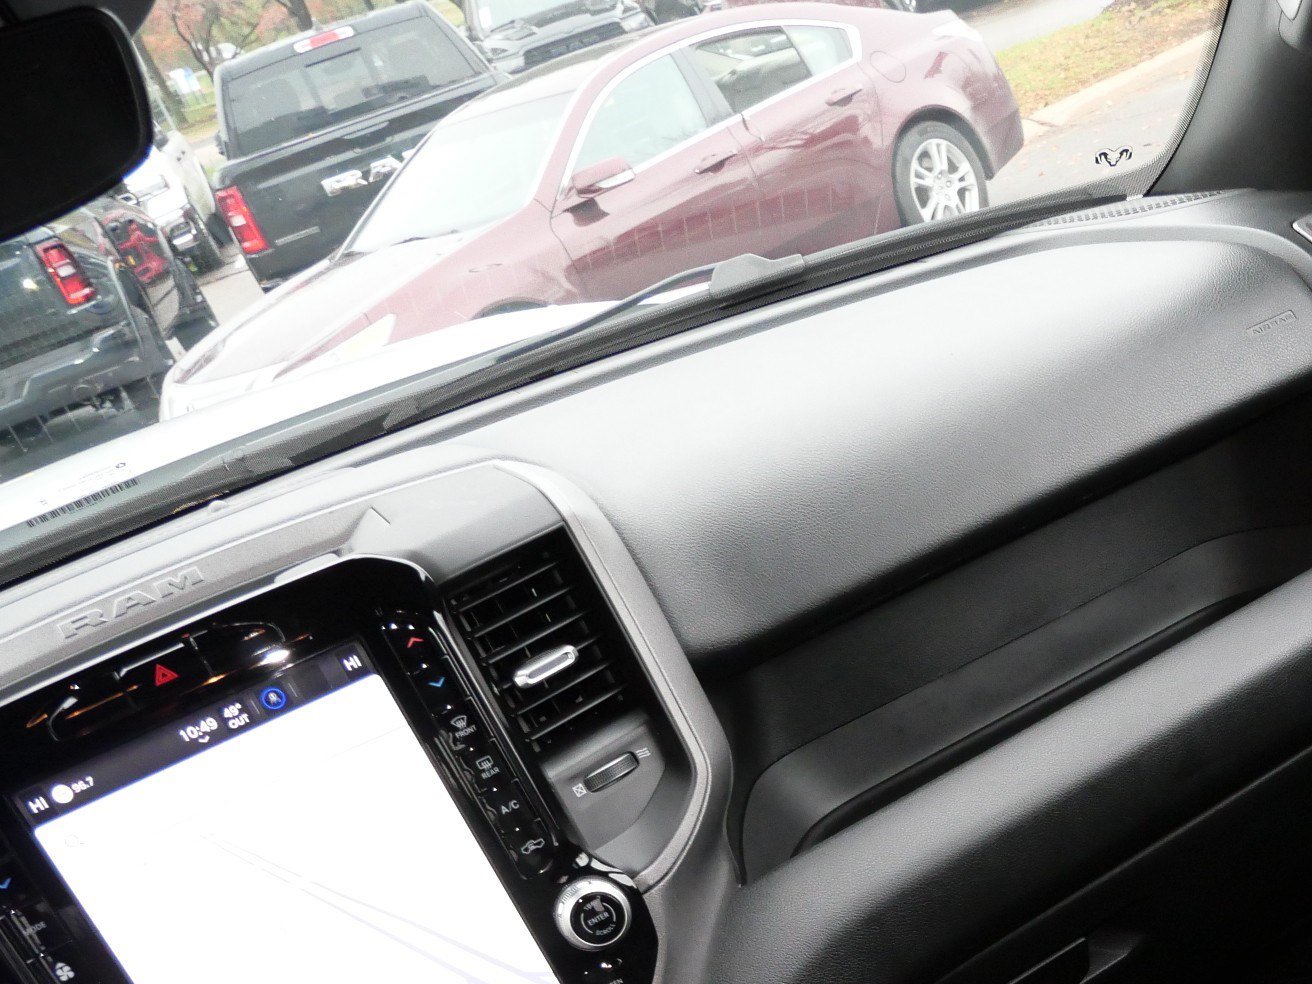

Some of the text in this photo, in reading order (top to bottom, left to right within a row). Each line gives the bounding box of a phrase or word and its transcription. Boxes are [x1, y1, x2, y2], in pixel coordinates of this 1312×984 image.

[56, 566, 204, 639] RAM
[343, 655, 363, 671] HI
[179, 717, 218, 742] 10:49
[228, 713, 250, 730] OUT
[455, 725, 477, 739] FRONT
[481, 767, 500, 779] REAR
[28, 796, 49, 813] HI
[500, 800, 520, 815] A/C
[587, 911, 610, 927] ENTER
